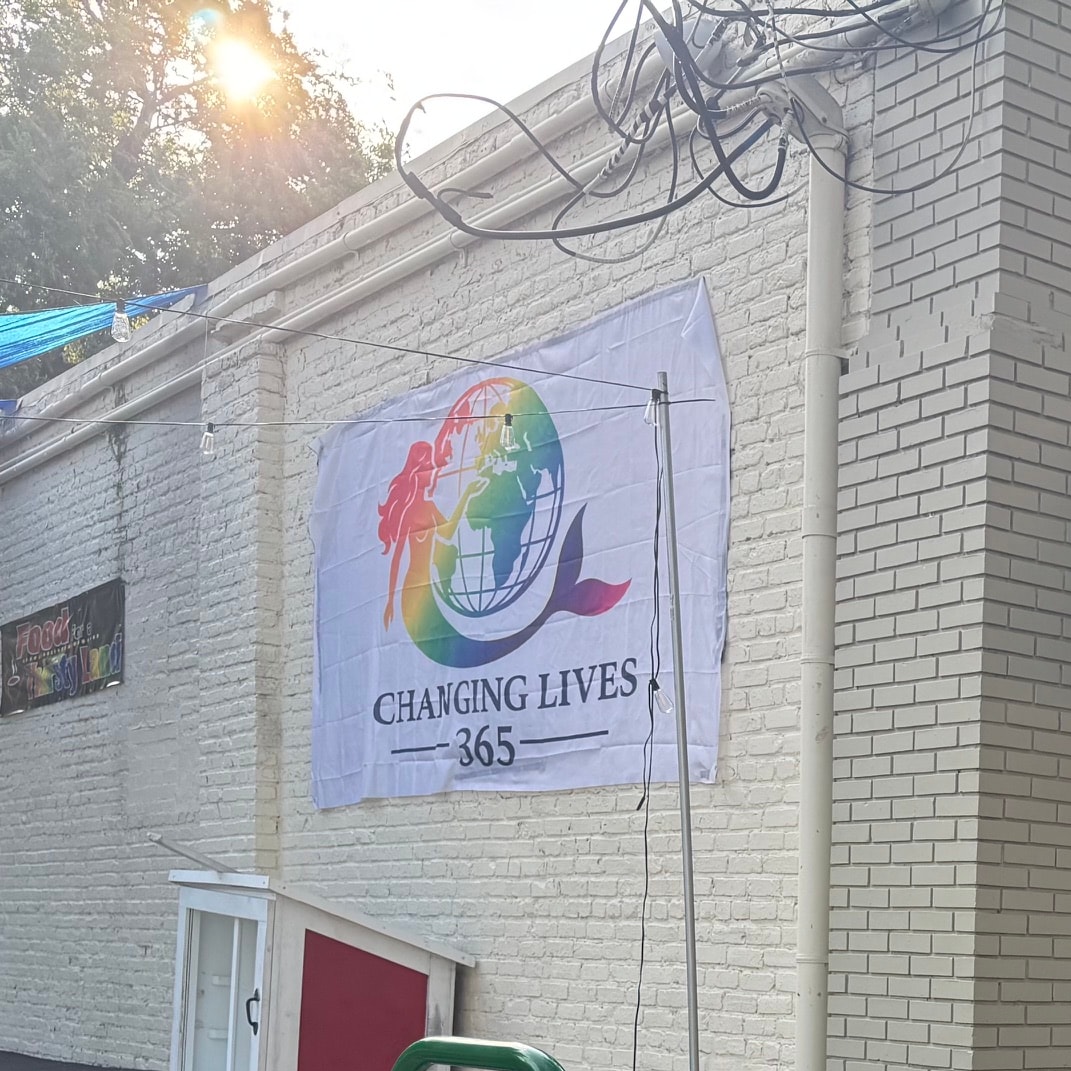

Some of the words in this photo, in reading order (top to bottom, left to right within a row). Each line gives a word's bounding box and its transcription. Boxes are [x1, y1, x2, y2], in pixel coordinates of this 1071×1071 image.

[16, 607, 70, 660] Food
[373, 674, 529, 725] CHANGING
[537, 657, 638, 709] LIVES
[456, 725, 516, 767] 365
